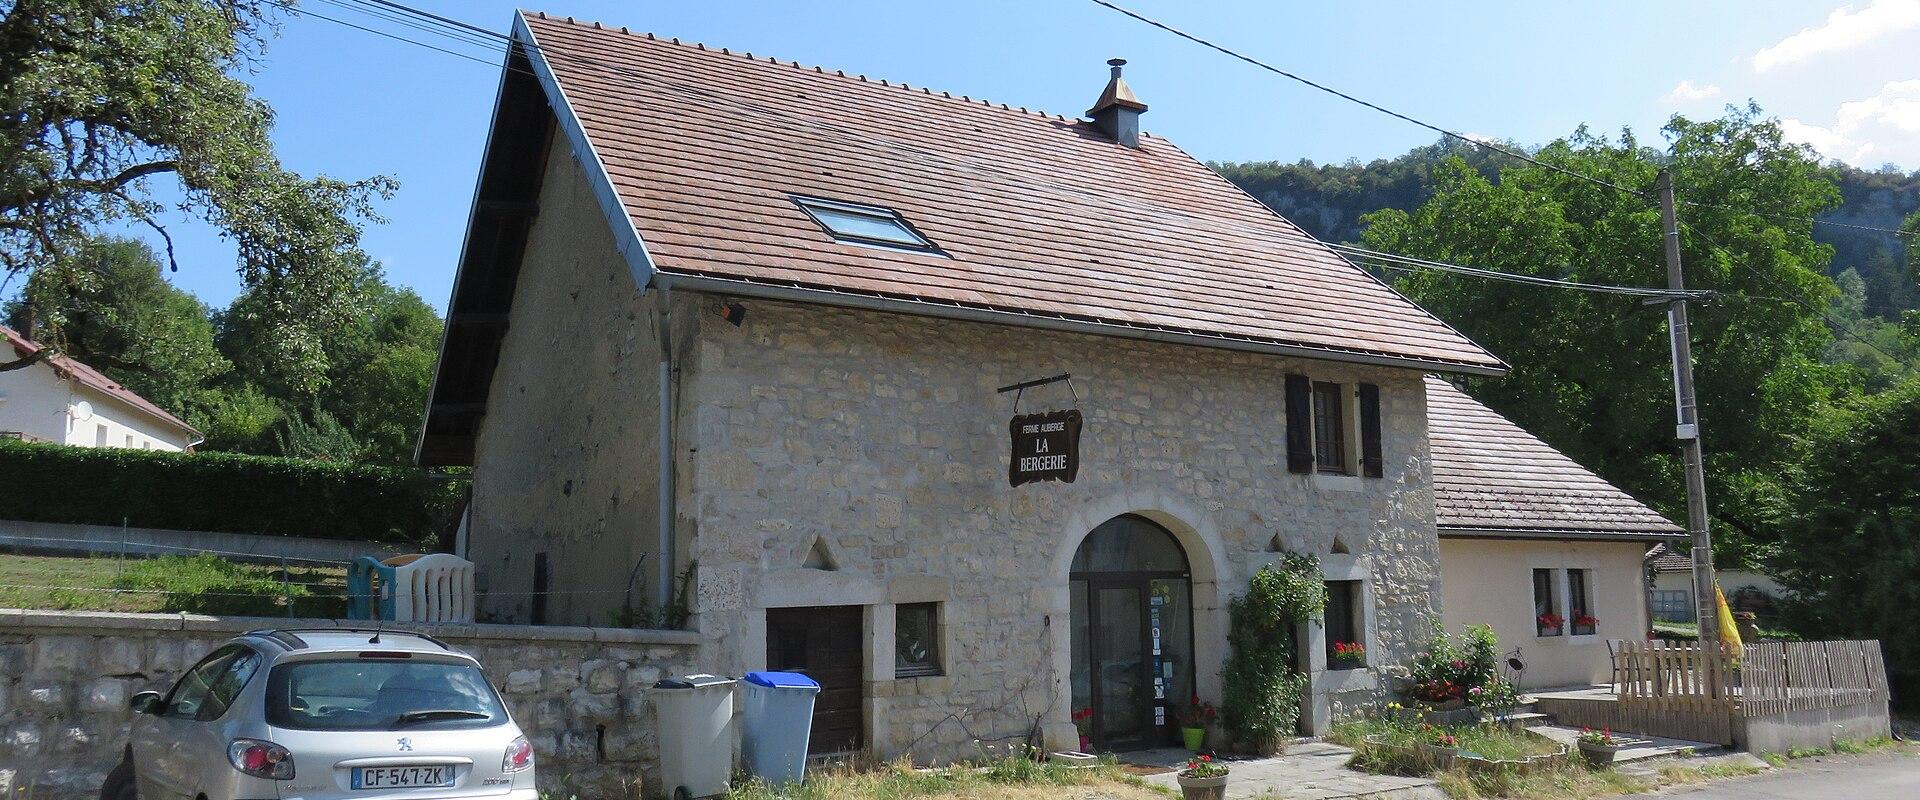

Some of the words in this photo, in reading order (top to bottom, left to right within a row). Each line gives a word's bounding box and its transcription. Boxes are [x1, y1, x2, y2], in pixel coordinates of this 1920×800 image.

[1023, 425, 1040, 434] FERME
[1041, 422, 1065, 432] AUBERGE
[1036, 438, 1049, 453] LA
[1020, 455, 1067, 472] BERGERIE
